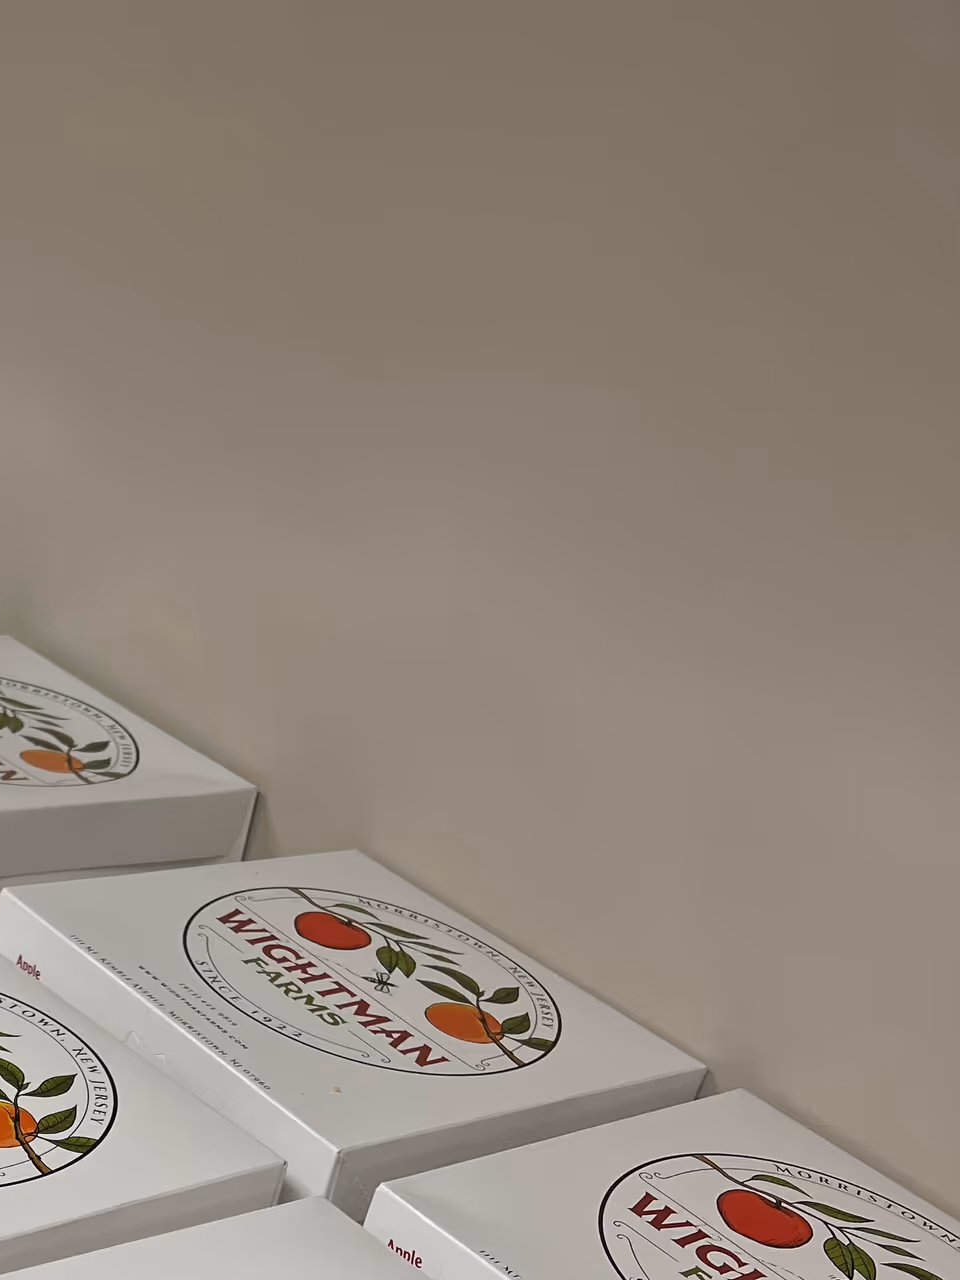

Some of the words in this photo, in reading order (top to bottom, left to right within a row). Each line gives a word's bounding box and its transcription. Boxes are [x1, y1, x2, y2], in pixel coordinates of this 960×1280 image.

[195, 959, 241, 1003] SINCE
[251, 1010, 303, 1039] 1922
[216, 908, 451, 1068] WIGHTMAN
[242, 956, 348, 1028] FARMS
[357, 898, 502, 962] MORRISTOWN,
[509, 966, 539, 991] NEW
[530, 991, 555, 1030] JERSEY
[72, 1046, 104, 1078] NEW
[89, 1077, 109, 1126] JERSEY
[478, 1250, 500, 1264] 1111
[501, 1265, 521, 1280] MT.
